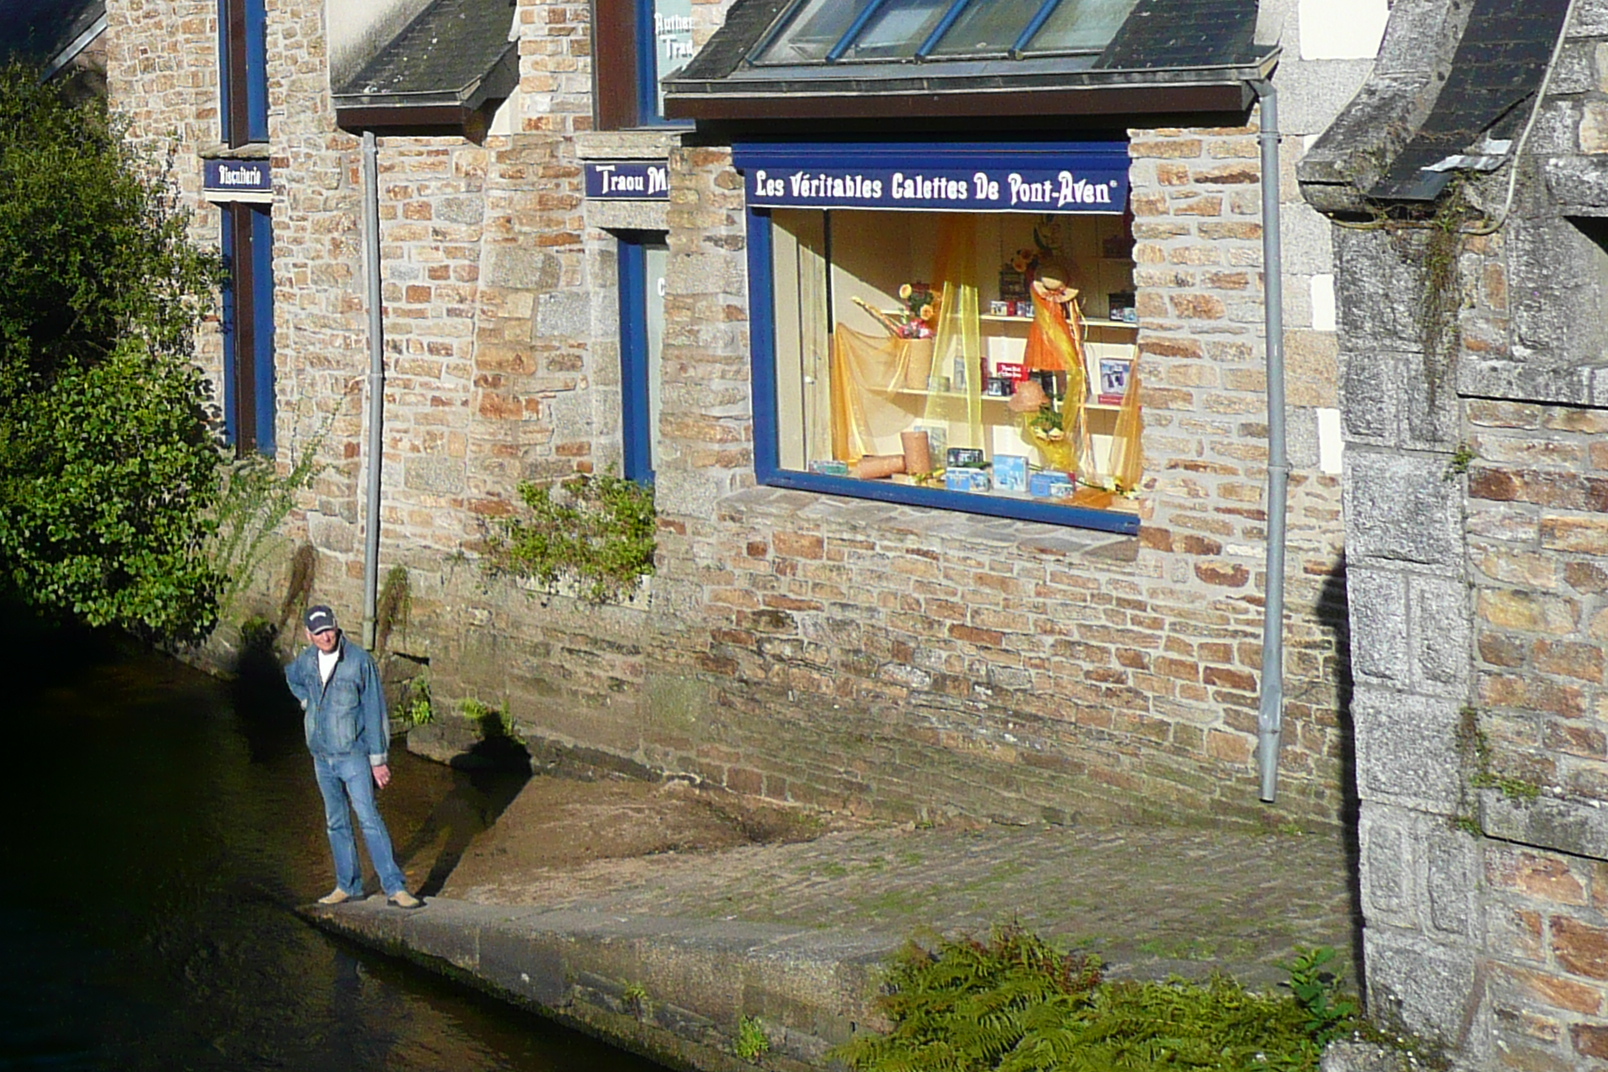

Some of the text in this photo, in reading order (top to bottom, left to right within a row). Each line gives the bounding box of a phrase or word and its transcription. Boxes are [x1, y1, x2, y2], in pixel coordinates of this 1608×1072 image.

[595, 165, 669, 195] Traou M
[755, 170, 785, 197] Les
[790, 171, 882, 198] Véritables
[892, 172, 968, 199] Galettes
[973, 172, 999, 200] De
